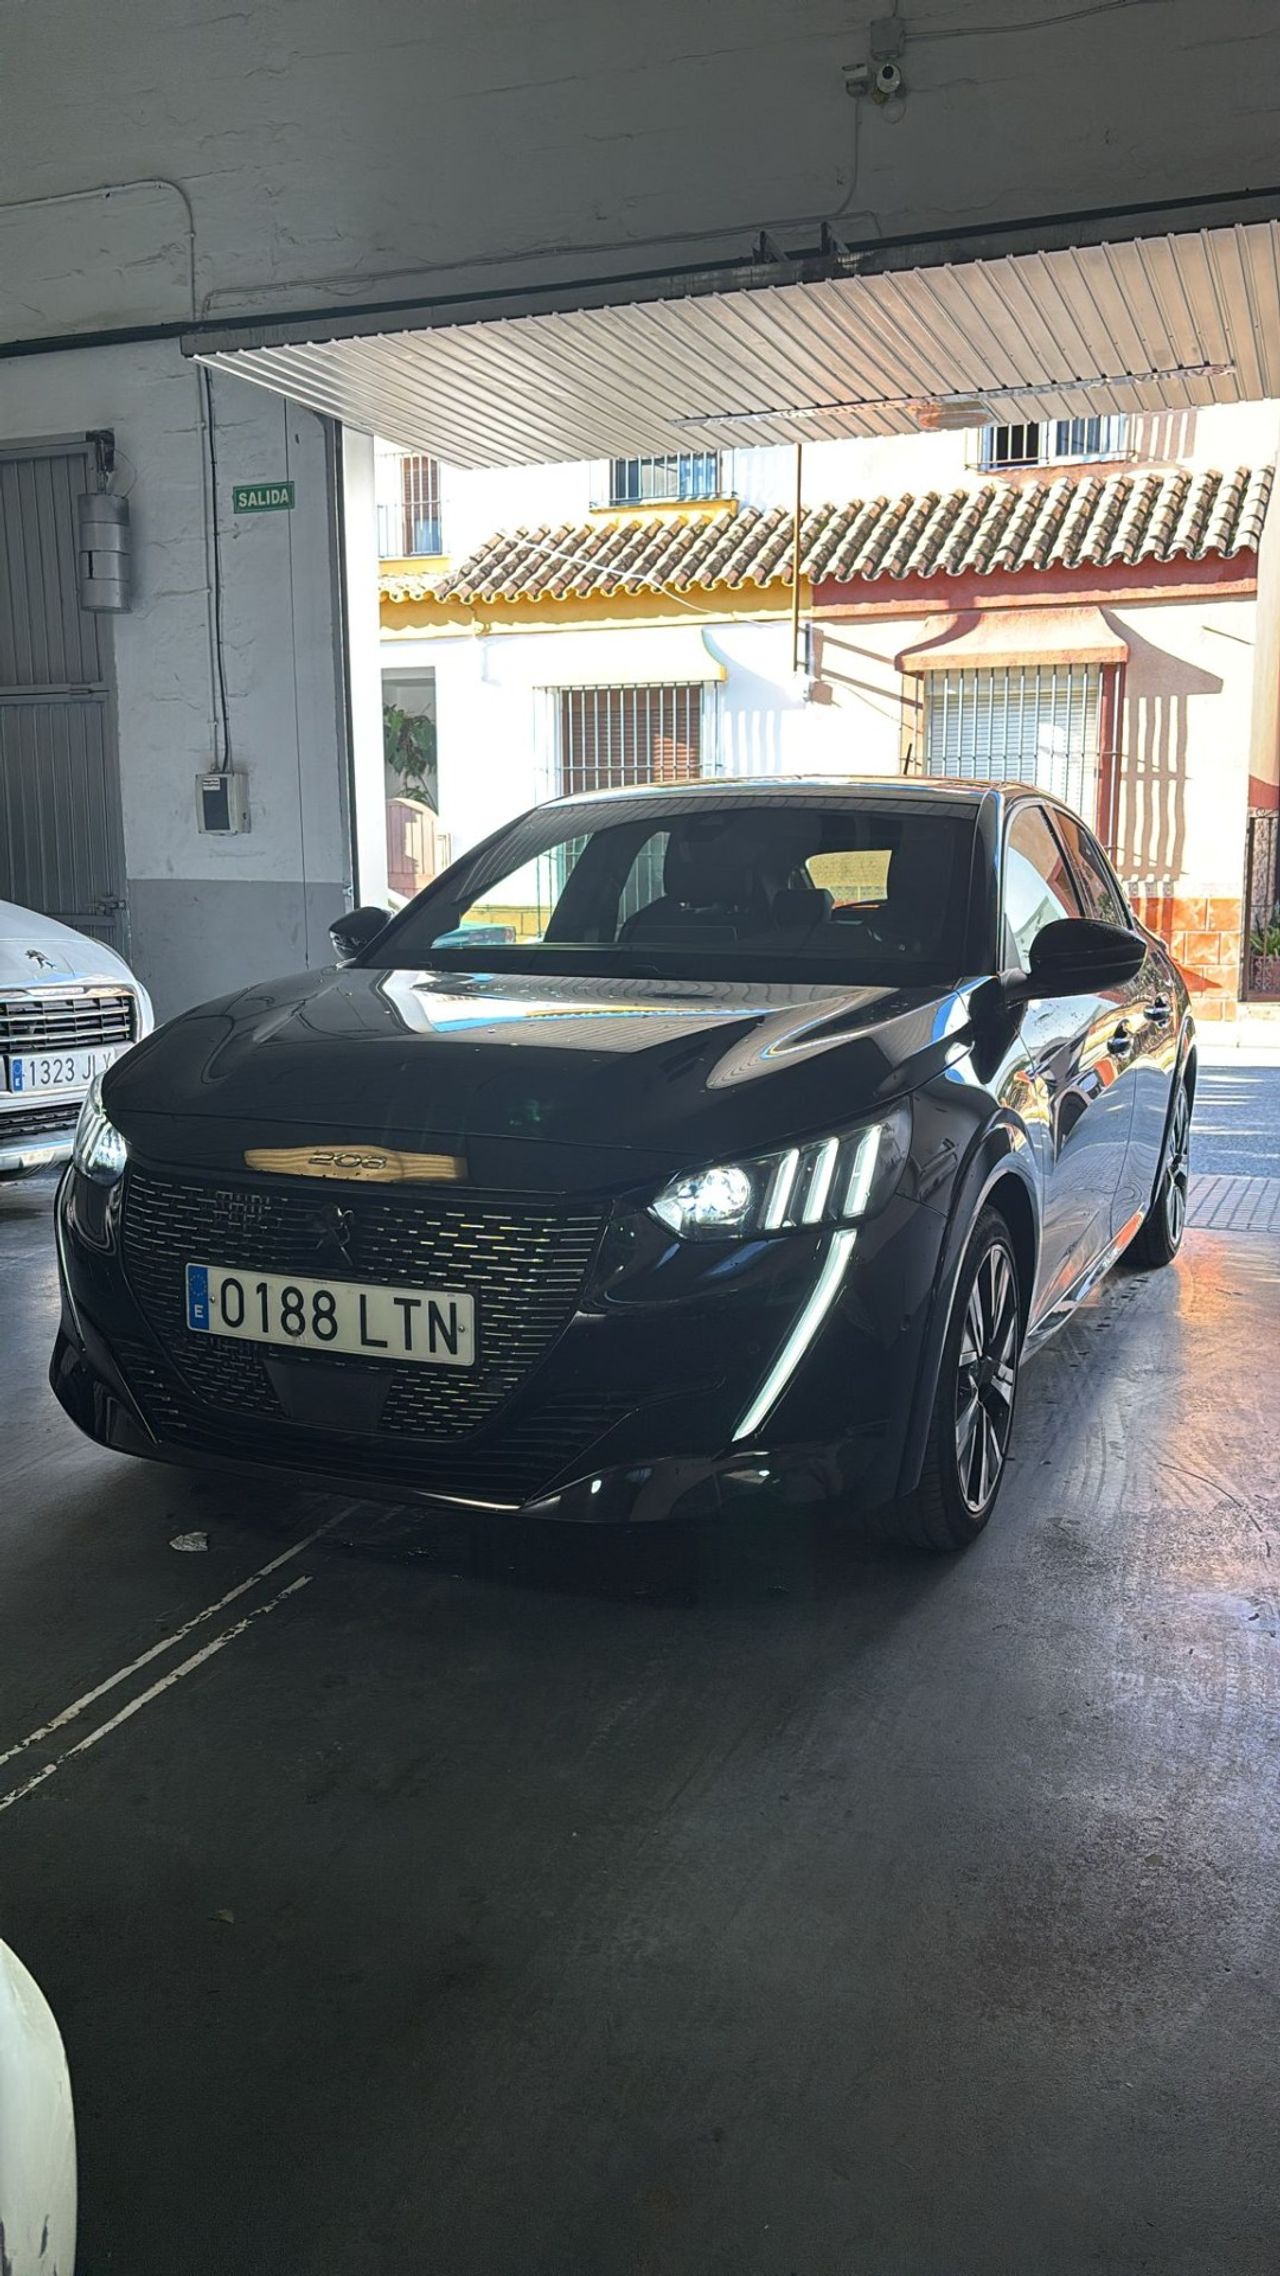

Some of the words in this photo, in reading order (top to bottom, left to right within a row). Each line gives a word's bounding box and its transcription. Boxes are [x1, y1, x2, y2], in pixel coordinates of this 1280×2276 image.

[238, 488, 290, 508] SALIDA
[30, 1057, 75, 1086] 1323
[308, 1151, 387, 1169] 208
[194, 1304, 204, 1318] E
[220, 1277, 338, 1341] 0188
[360, 1294, 458, 1355] LTN
